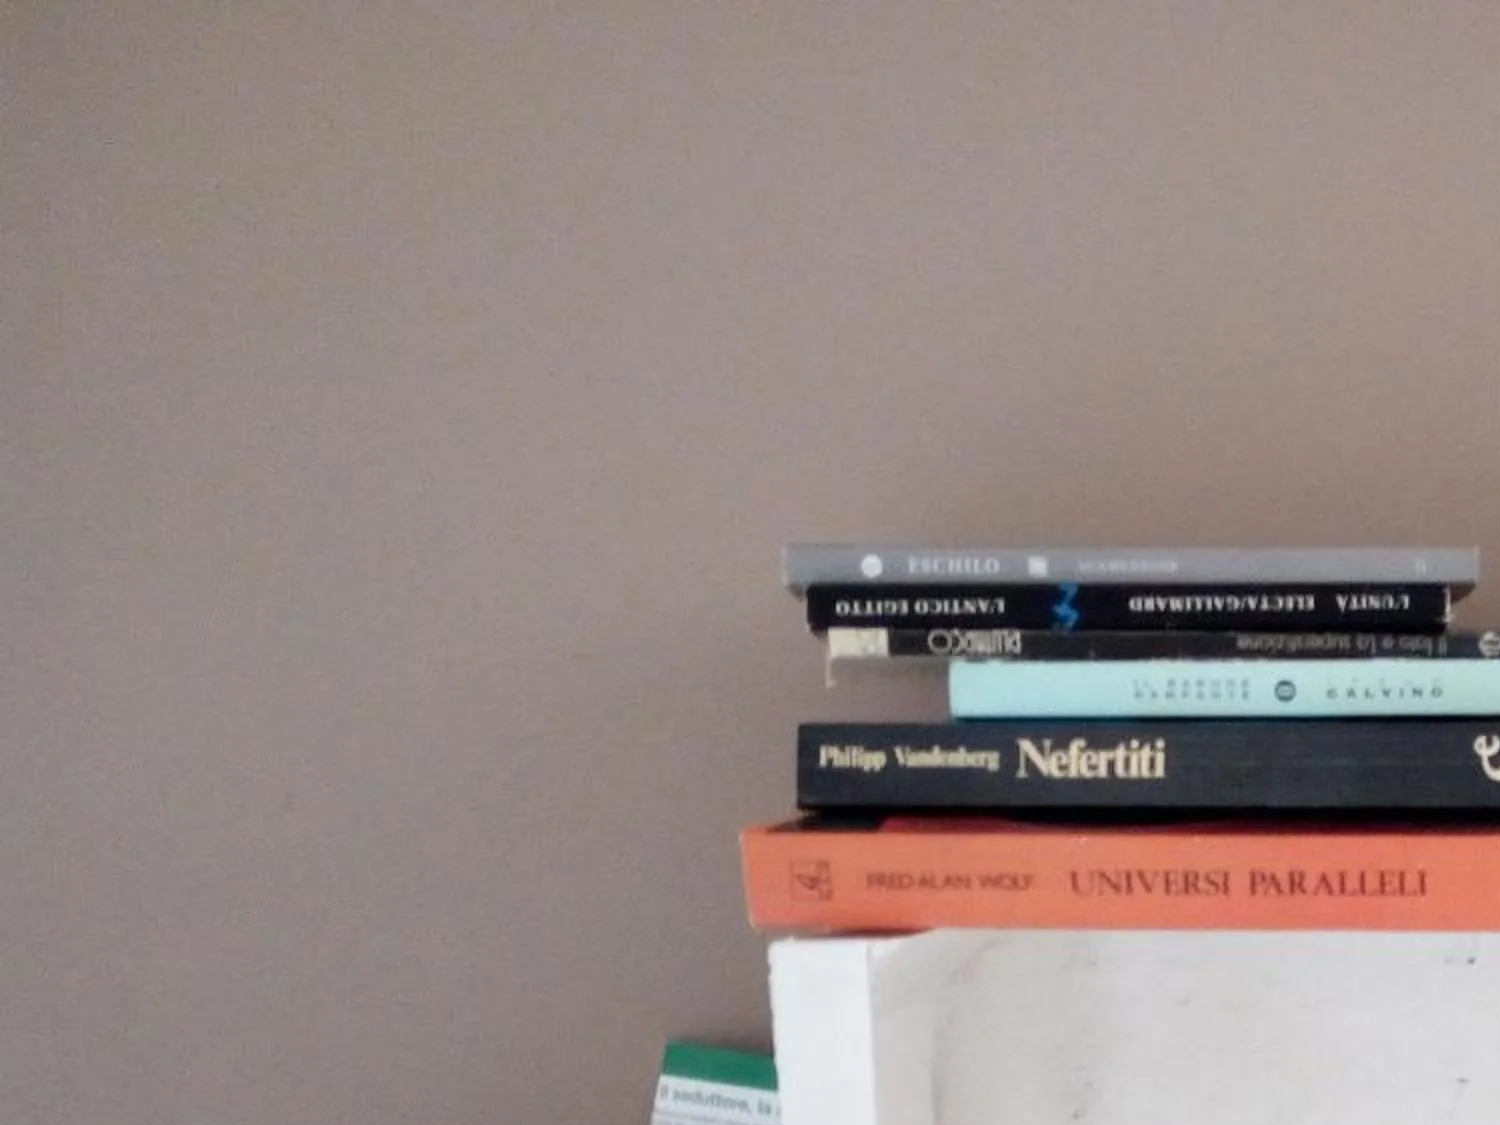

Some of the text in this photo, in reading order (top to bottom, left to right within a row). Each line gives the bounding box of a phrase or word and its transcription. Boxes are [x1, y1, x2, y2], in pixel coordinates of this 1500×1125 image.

[909, 556, 1000, 574] ESCHILO
[836, 600, 908, 617] EGITTO
[1129, 594, 1315, 612] ELECTA/GALLIMARD
[1327, 686, 1444, 699] CALVINO
[820, 746, 1000, 772] Philipp Vandenberg
[1016, 737, 1166, 779] Nefertiti
[916, 871, 972, 891] ALAN
[977, 871, 1035, 891] WOLF
[1069, 869, 1427, 898] UNIVERSI PARALLELI
